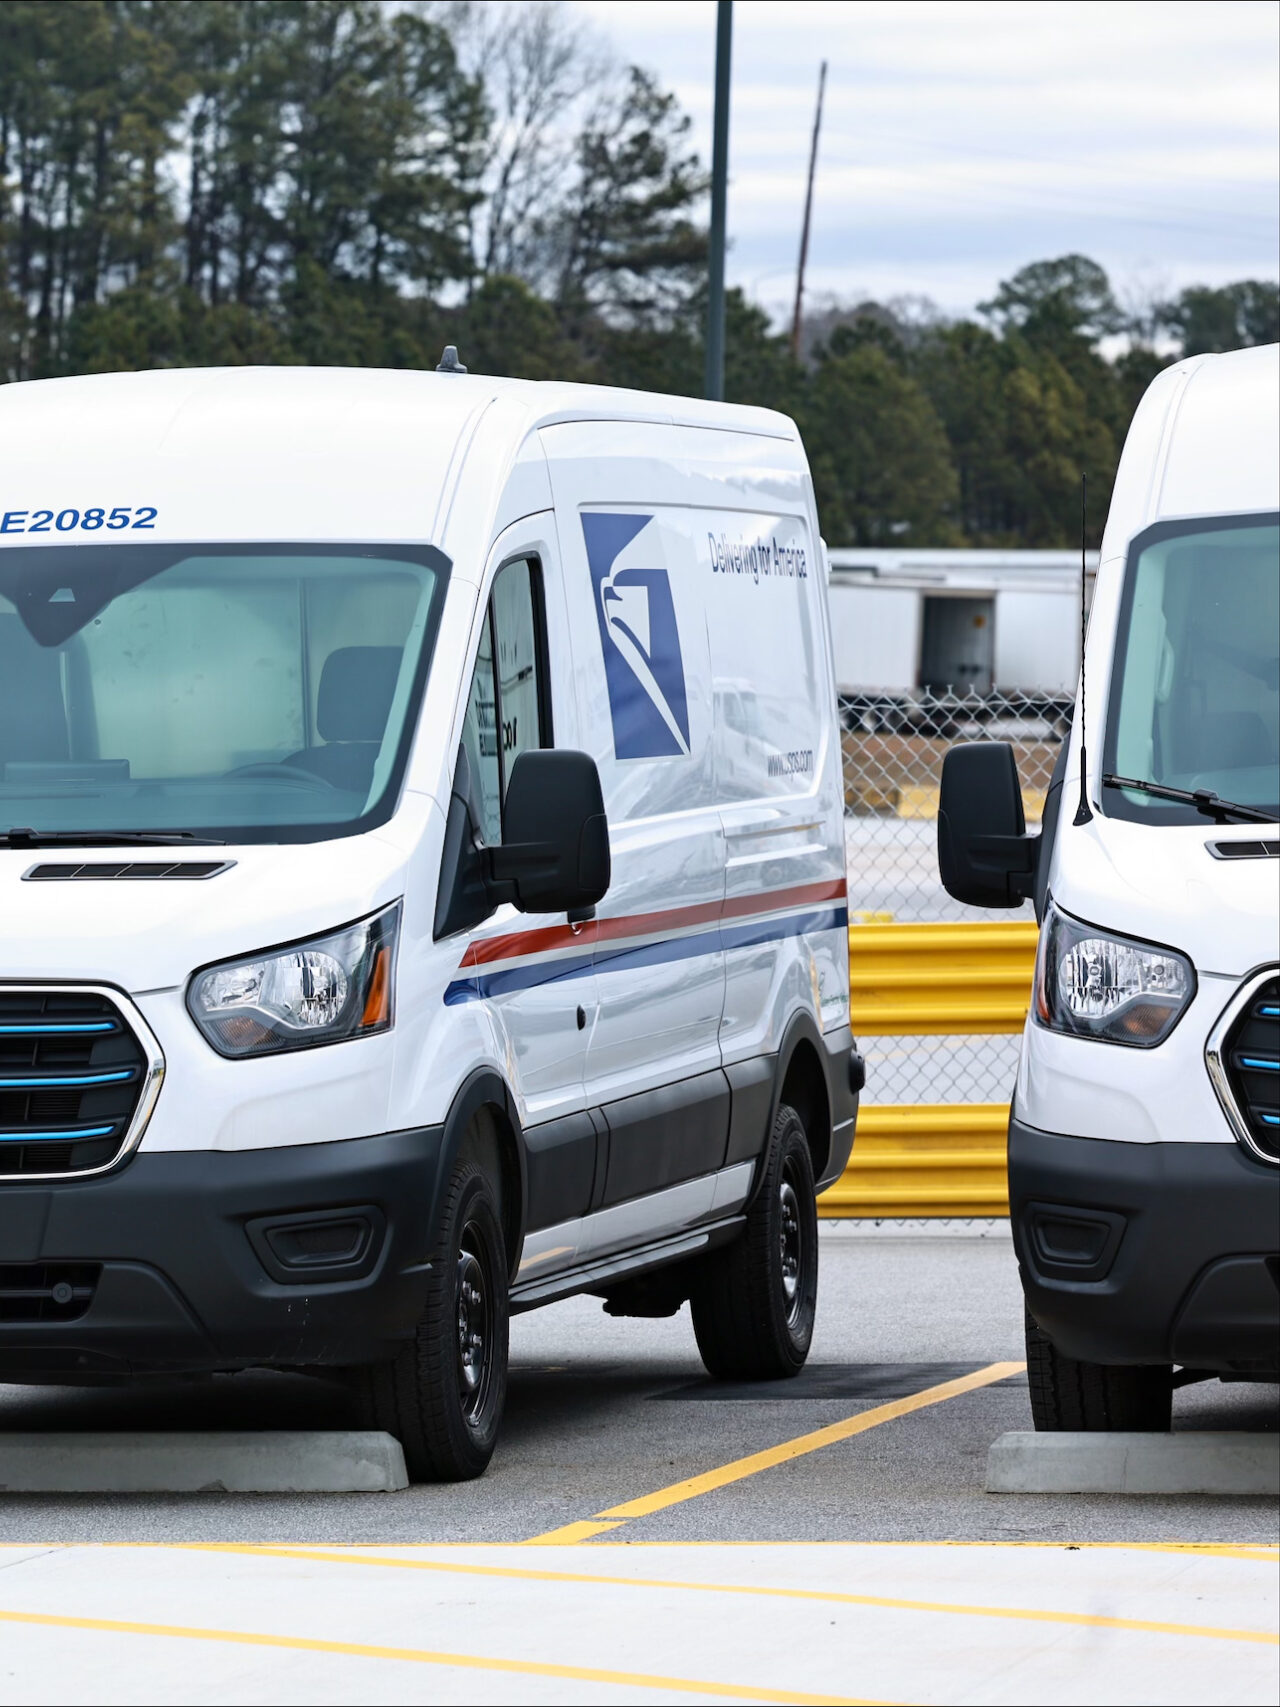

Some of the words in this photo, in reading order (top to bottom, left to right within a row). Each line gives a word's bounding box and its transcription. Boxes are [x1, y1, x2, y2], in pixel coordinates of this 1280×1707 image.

[707, 532, 760, 585] Delivering
[757, 536, 771, 576] for
[772, 536, 807, 578] America
